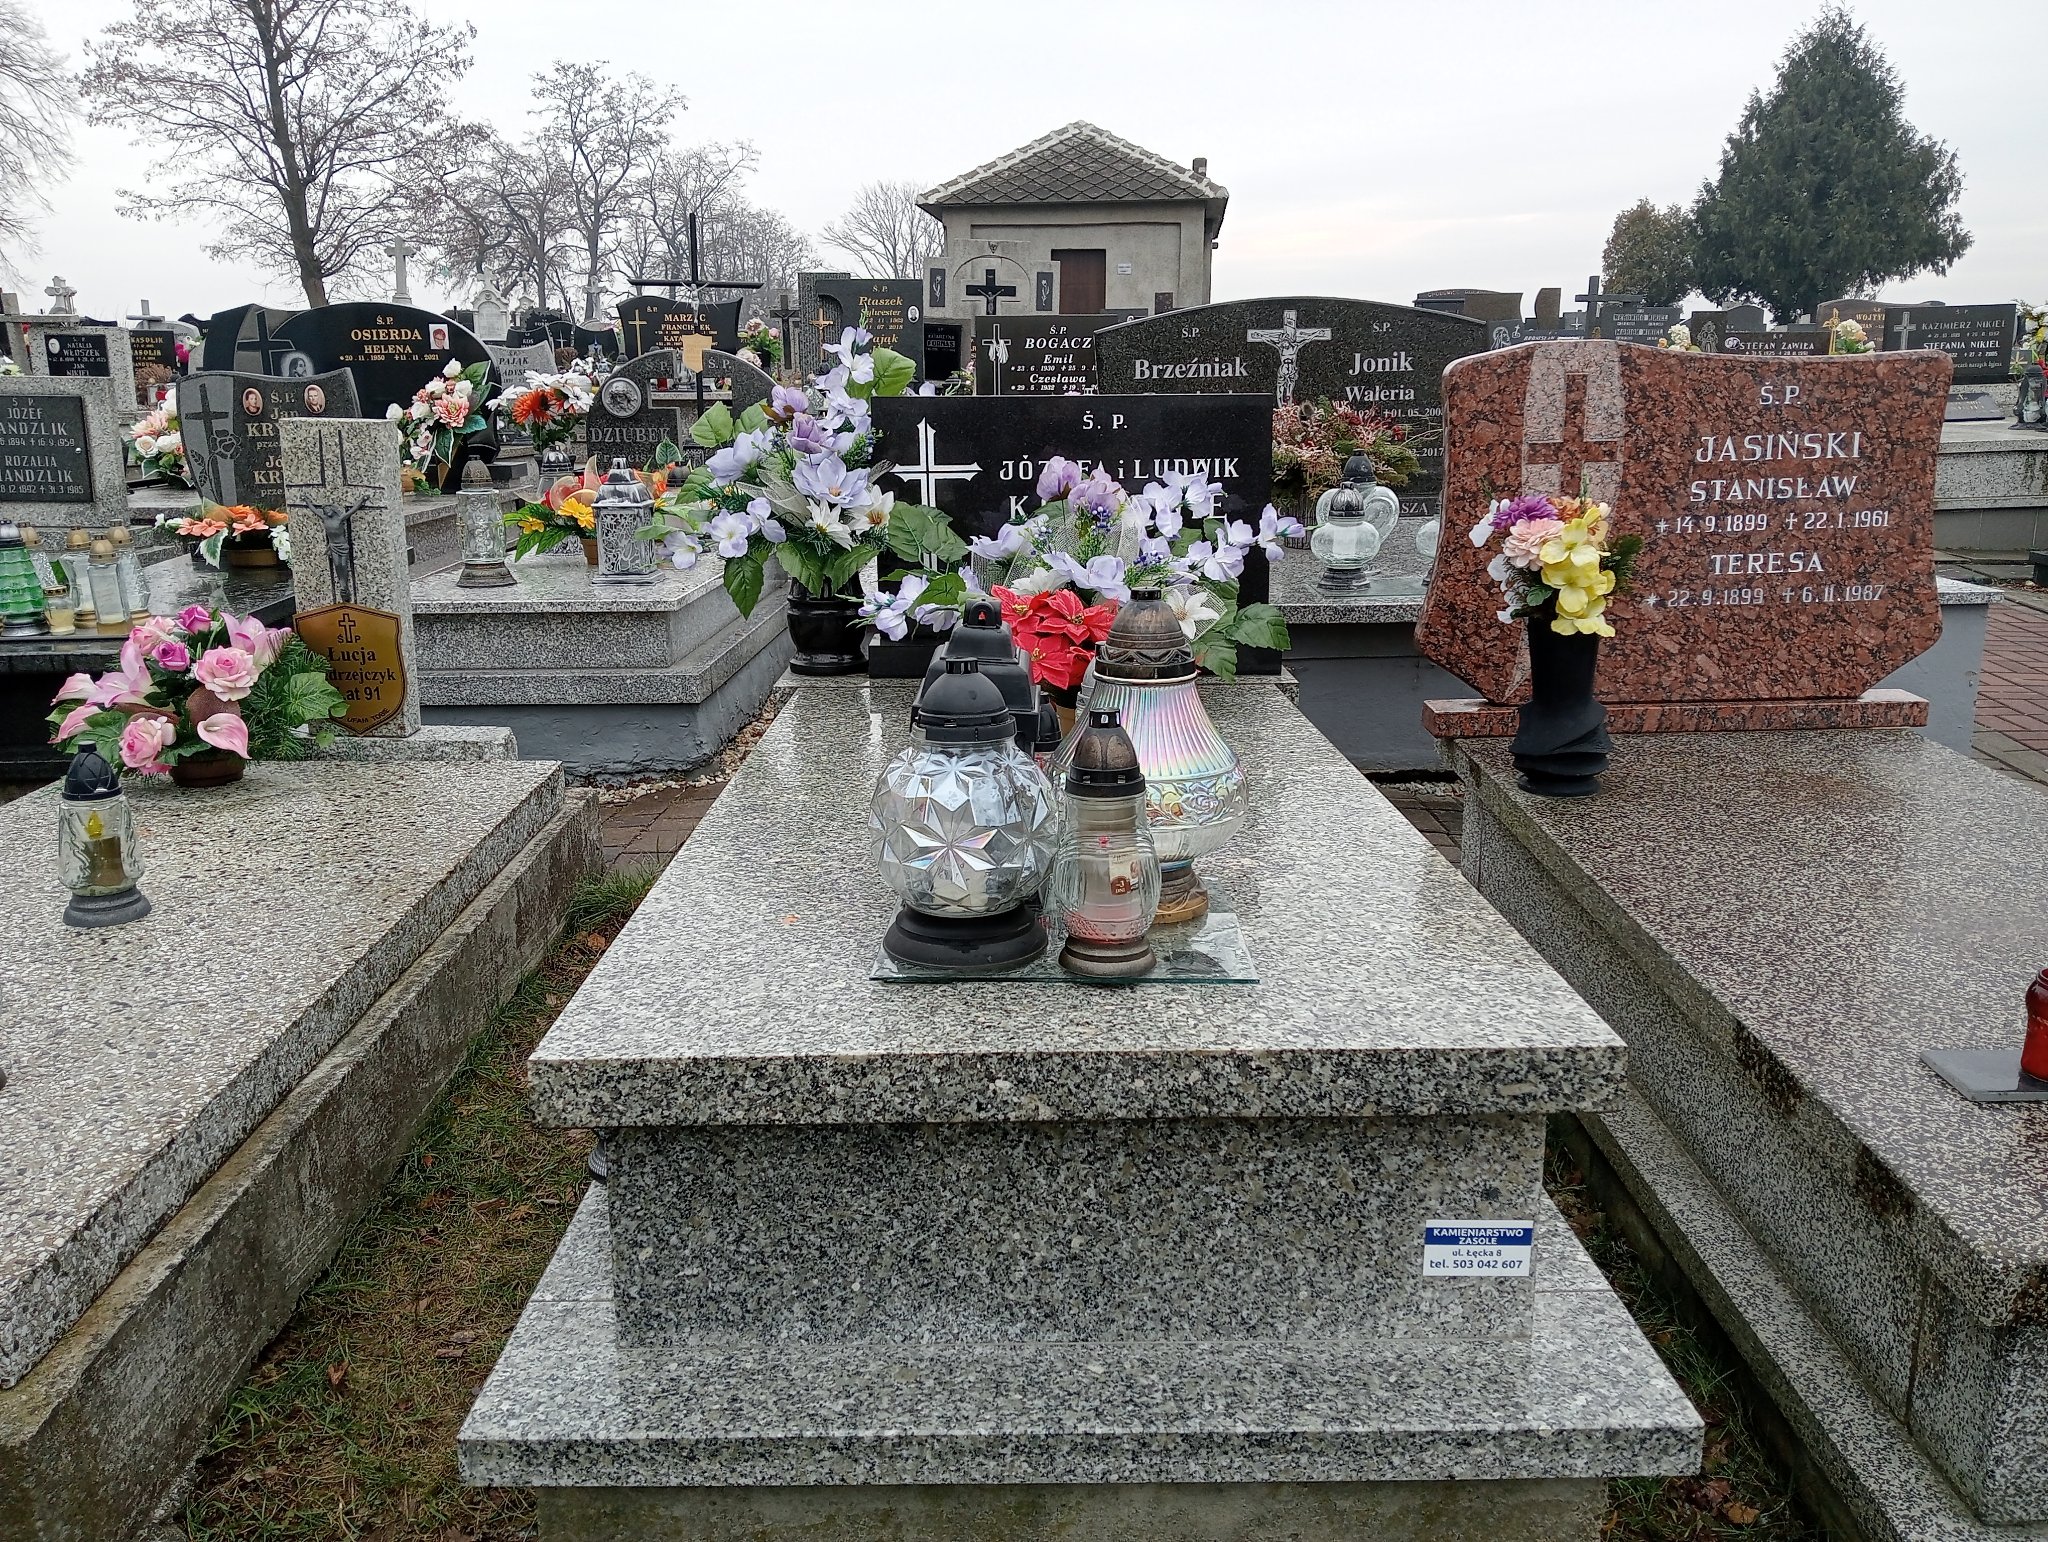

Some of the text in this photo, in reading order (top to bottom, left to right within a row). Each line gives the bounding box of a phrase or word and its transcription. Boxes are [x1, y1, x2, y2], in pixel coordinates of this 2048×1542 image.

[858, 296, 904, 306] Ptaszek
[664, 313, 706, 322] MARZC
[660, 323, 712, 331] FRANCISEK
[1922, 320, 2006, 330] KAZIMIERZ NIKIEL
[350, 328, 422, 341] OSIERDA
[872, 334, 898, 345] ająk
[363, 344, 413, 354] HELENA
[1024, 337, 1093, 349] BOGACZ
[1739, 342, 1776, 350] STEFAN
[1923, 340, 2001, 350] STEFANIA NIKIEL
[1043, 354, 1074, 364] Emil
[1348, 351, 1415, 376] Jonik
[1134, 356, 1251, 380] Brzeźniak
[1345, 384, 1416, 402] Waleria
[270, 407, 299, 420] Jan
[0, 422, 69, 436] ANDZLIK
[589, 427, 671, 443] DZIUBEK
[1696, 430, 1862, 463] JASIŃSKI
[4, 455, 58, 468] ROZALIA
[1118, 460, 1125, 479] i
[1133, 458, 1240, 480] LUDWIK
[0, 469, 74, 483] ANDZLIK
[1690, 476, 1859, 502] STANISŁAW
[1710, 552, 1825, 575] TERESA
[327, 647, 377, 666] Łucja
[328, 668, 397, 685] drzejczyk
[346, 686, 381, 701] at 91
[1433, 1228, 1524, 1238] KAMIENIARSTWO
[1458, 1237, 1498, 1246] ZASOLE
[1452, 1249, 1502, 1258] ul. Łęcka 8
[1429, 1259, 1523, 1270] tel. 503 042 607
